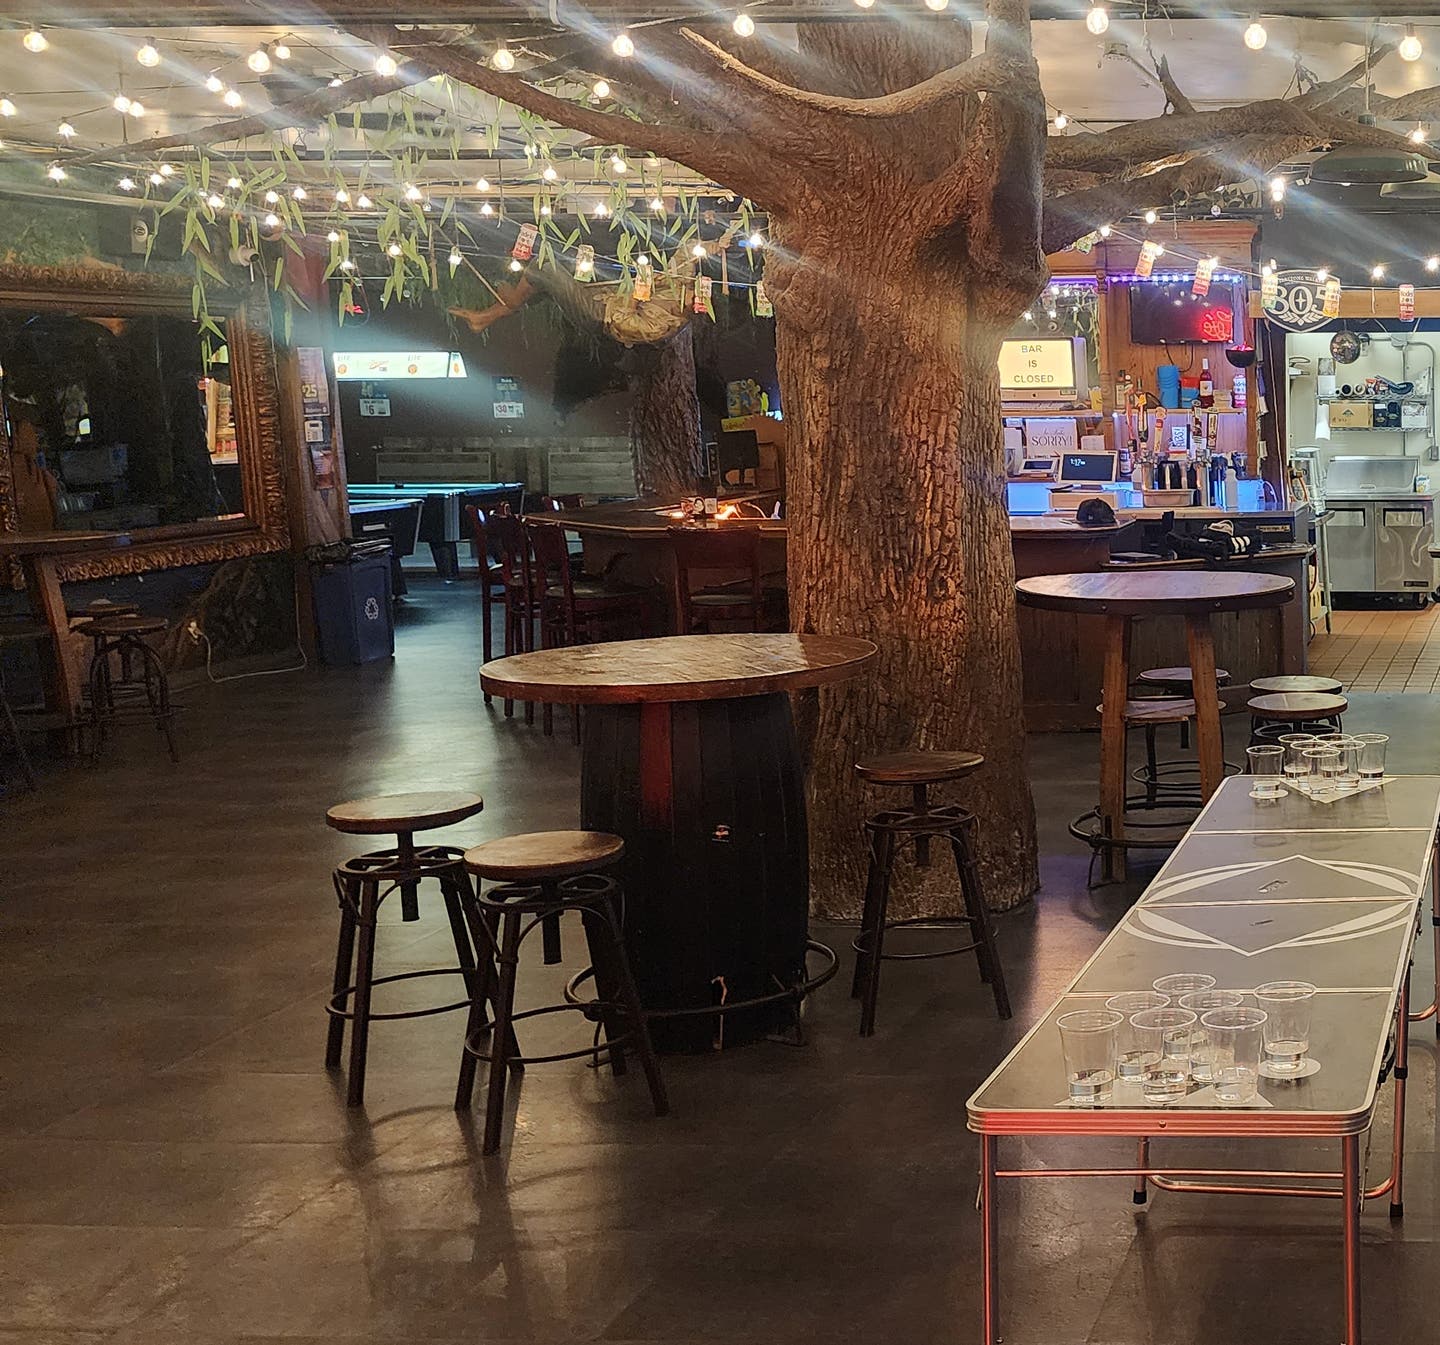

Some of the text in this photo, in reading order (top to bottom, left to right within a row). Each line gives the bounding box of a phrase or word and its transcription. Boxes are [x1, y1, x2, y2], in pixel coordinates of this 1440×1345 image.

[1021, 344, 1042, 353] BAR
[1028, 359, 1038, 368] IS
[1013, 374, 1054, 383] CLOSED
[1031, 435, 1073, 447] SORRY!
